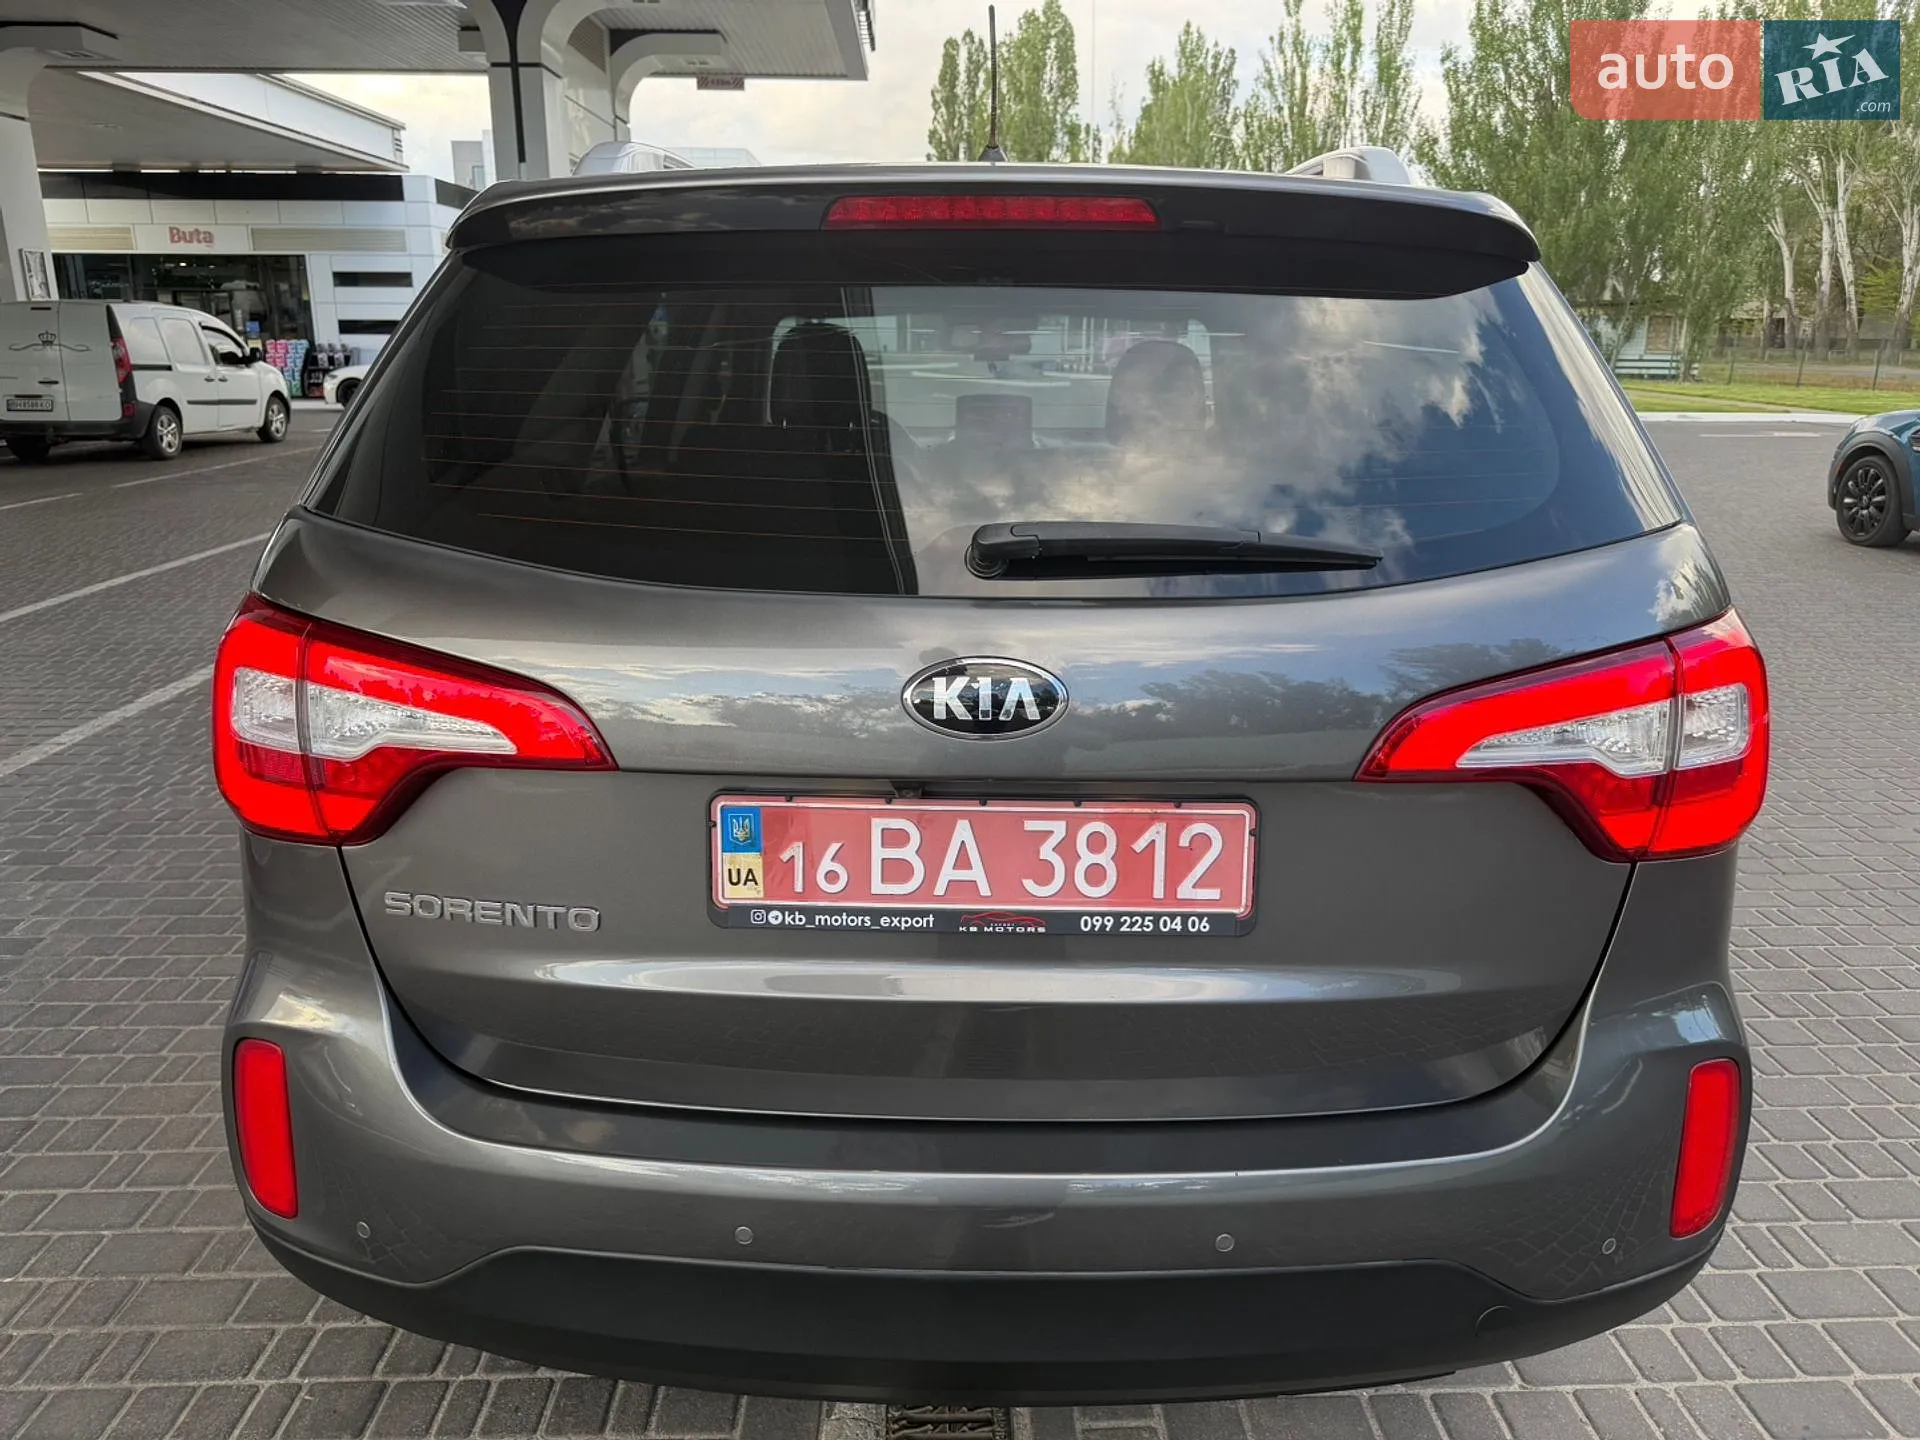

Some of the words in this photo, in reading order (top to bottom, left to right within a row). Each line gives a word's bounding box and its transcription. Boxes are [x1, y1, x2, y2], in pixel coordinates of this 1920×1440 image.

[169, 226, 214, 243] Buta
[931, 676, 1042, 721] KIA
[779, 841, 849, 895] 16
[869, 817, 992, 897] BA
[1022, 820, 1223, 900] 3812
[727, 867, 759, 887] UA
[383, 890, 602, 932] SORENTO
[784, 911, 935, 930] kb_motors_export
[1080, 915, 1114, 932] 099
[1120, 916, 1154, 932] 225
[1159, 916, 1182, 932] 04
[1187, 916, 1210, 932] 06
